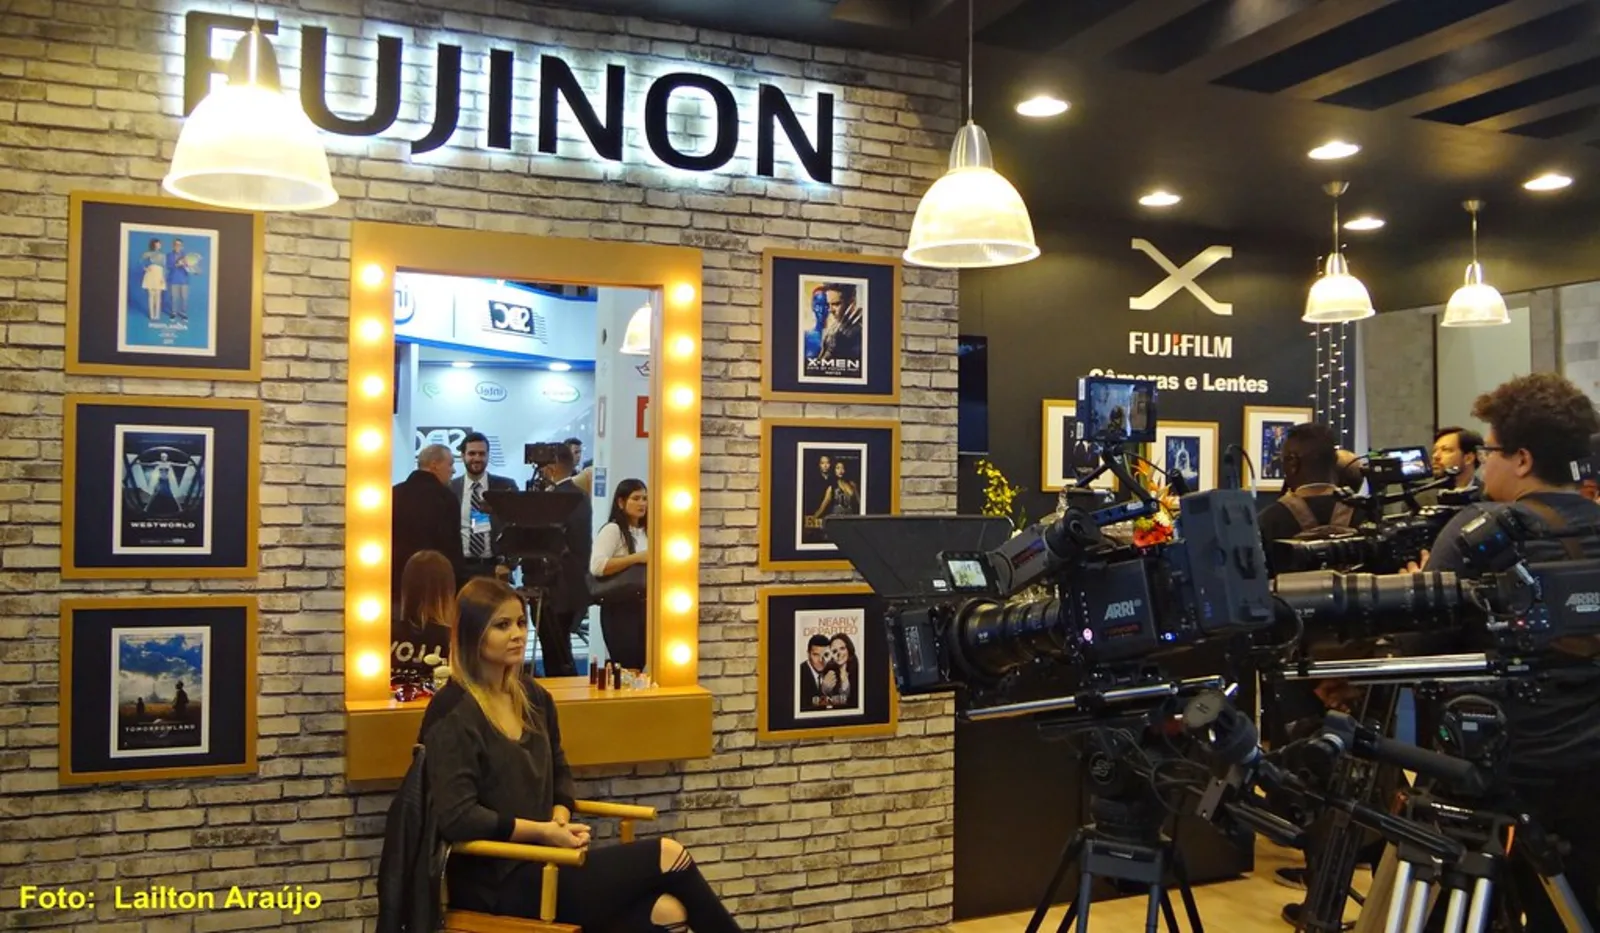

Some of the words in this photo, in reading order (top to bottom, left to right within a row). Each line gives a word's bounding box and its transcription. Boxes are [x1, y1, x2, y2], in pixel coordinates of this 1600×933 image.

[183, 11, 834, 185] FUJINON
[1129, 331, 1233, 359] FUJIFILM
[1185, 375, 1198, 391] e
[1203, 373, 1269, 394] Lentes
[130, 521, 196, 529] WESTWORLD
[1103, 599, 1136, 621] ARRI
[818, 616, 858, 627] NEARLY
[125, 723, 196, 733] TOMORROWLAND
